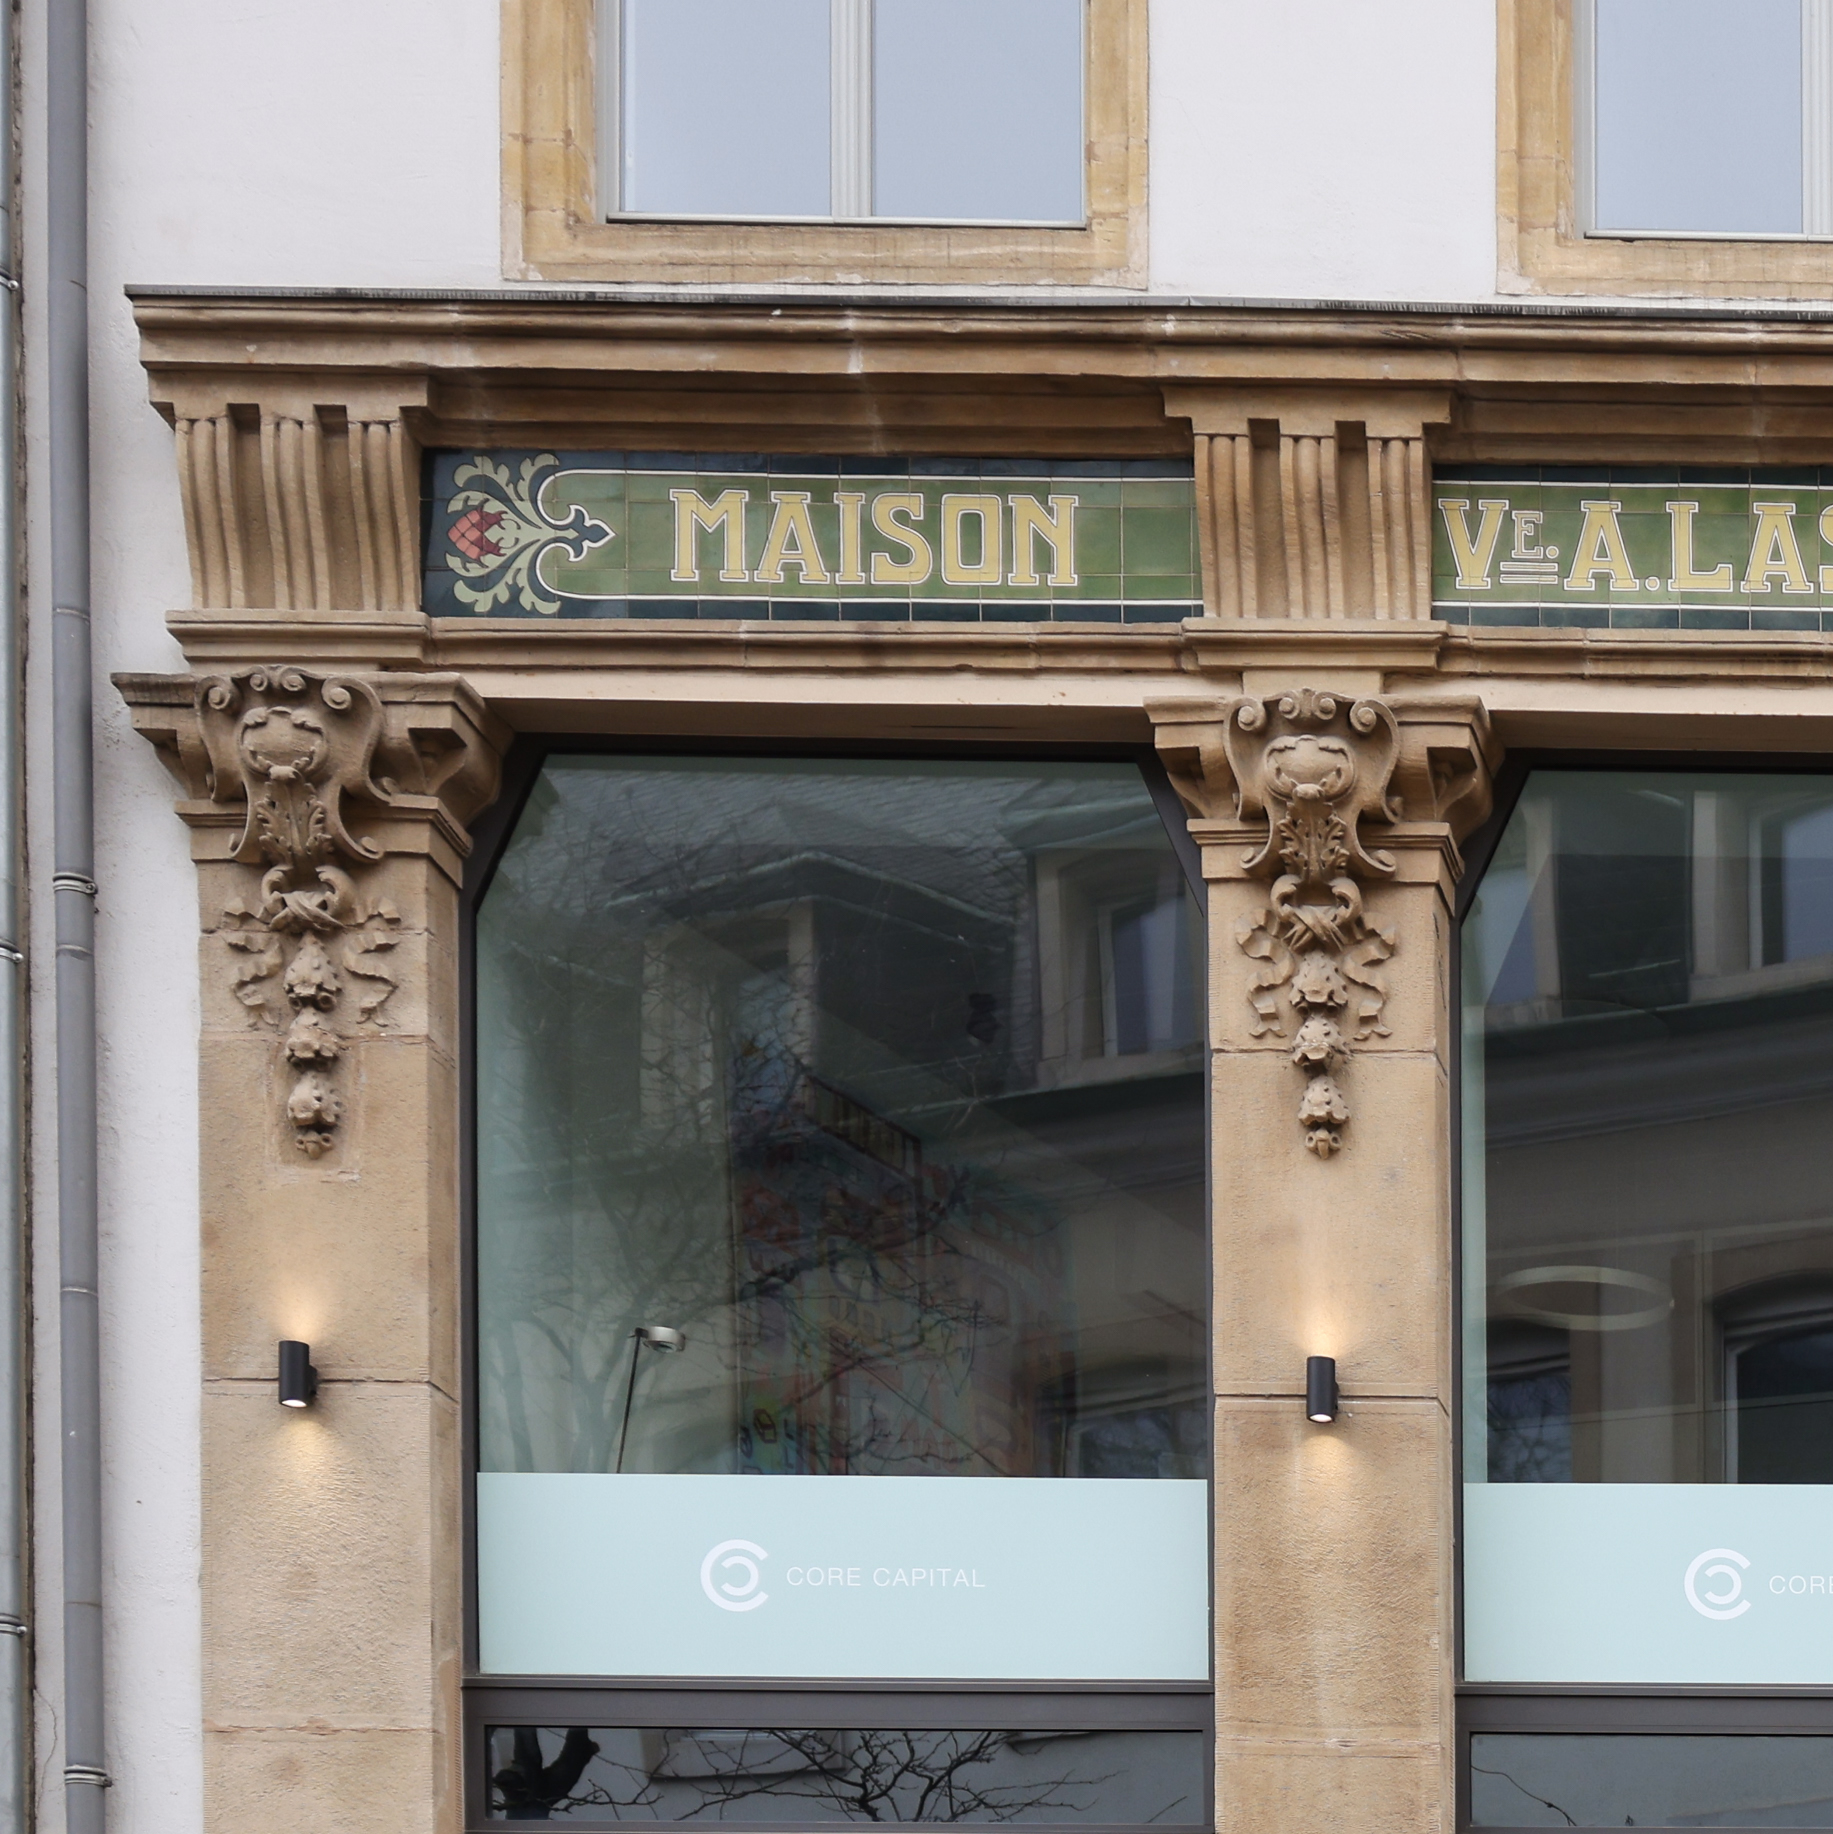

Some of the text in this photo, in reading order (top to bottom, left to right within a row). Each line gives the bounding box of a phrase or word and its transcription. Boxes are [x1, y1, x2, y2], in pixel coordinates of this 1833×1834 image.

[669, 487, 1079, 587] MAISON
[786, 1565, 987, 1589] CORE CAPITAL
